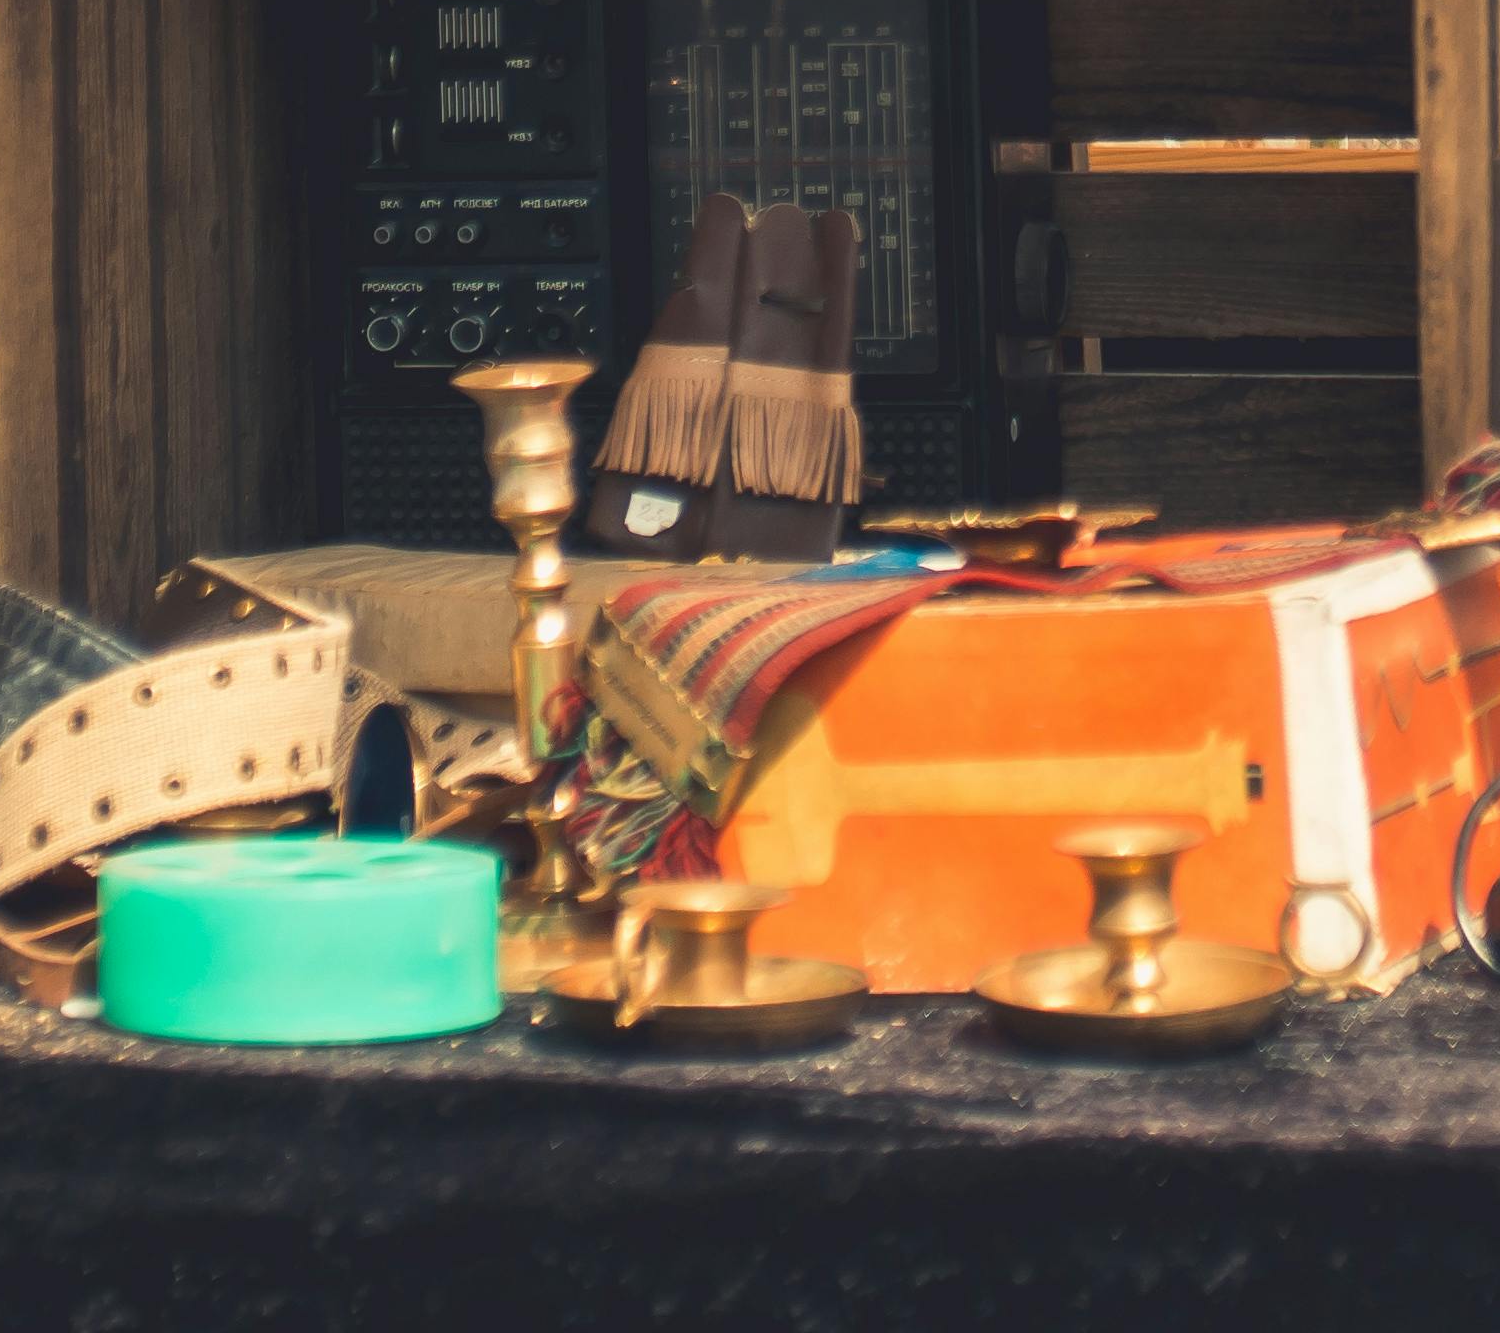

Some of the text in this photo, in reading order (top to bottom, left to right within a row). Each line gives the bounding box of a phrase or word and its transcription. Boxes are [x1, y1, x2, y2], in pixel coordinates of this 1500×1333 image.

[361, 282, 423, 293] ГРОМКОСТЬ
[452, 282, 484, 292] ТЕМБР
[535, 281, 567, 292] ТЕМБР
